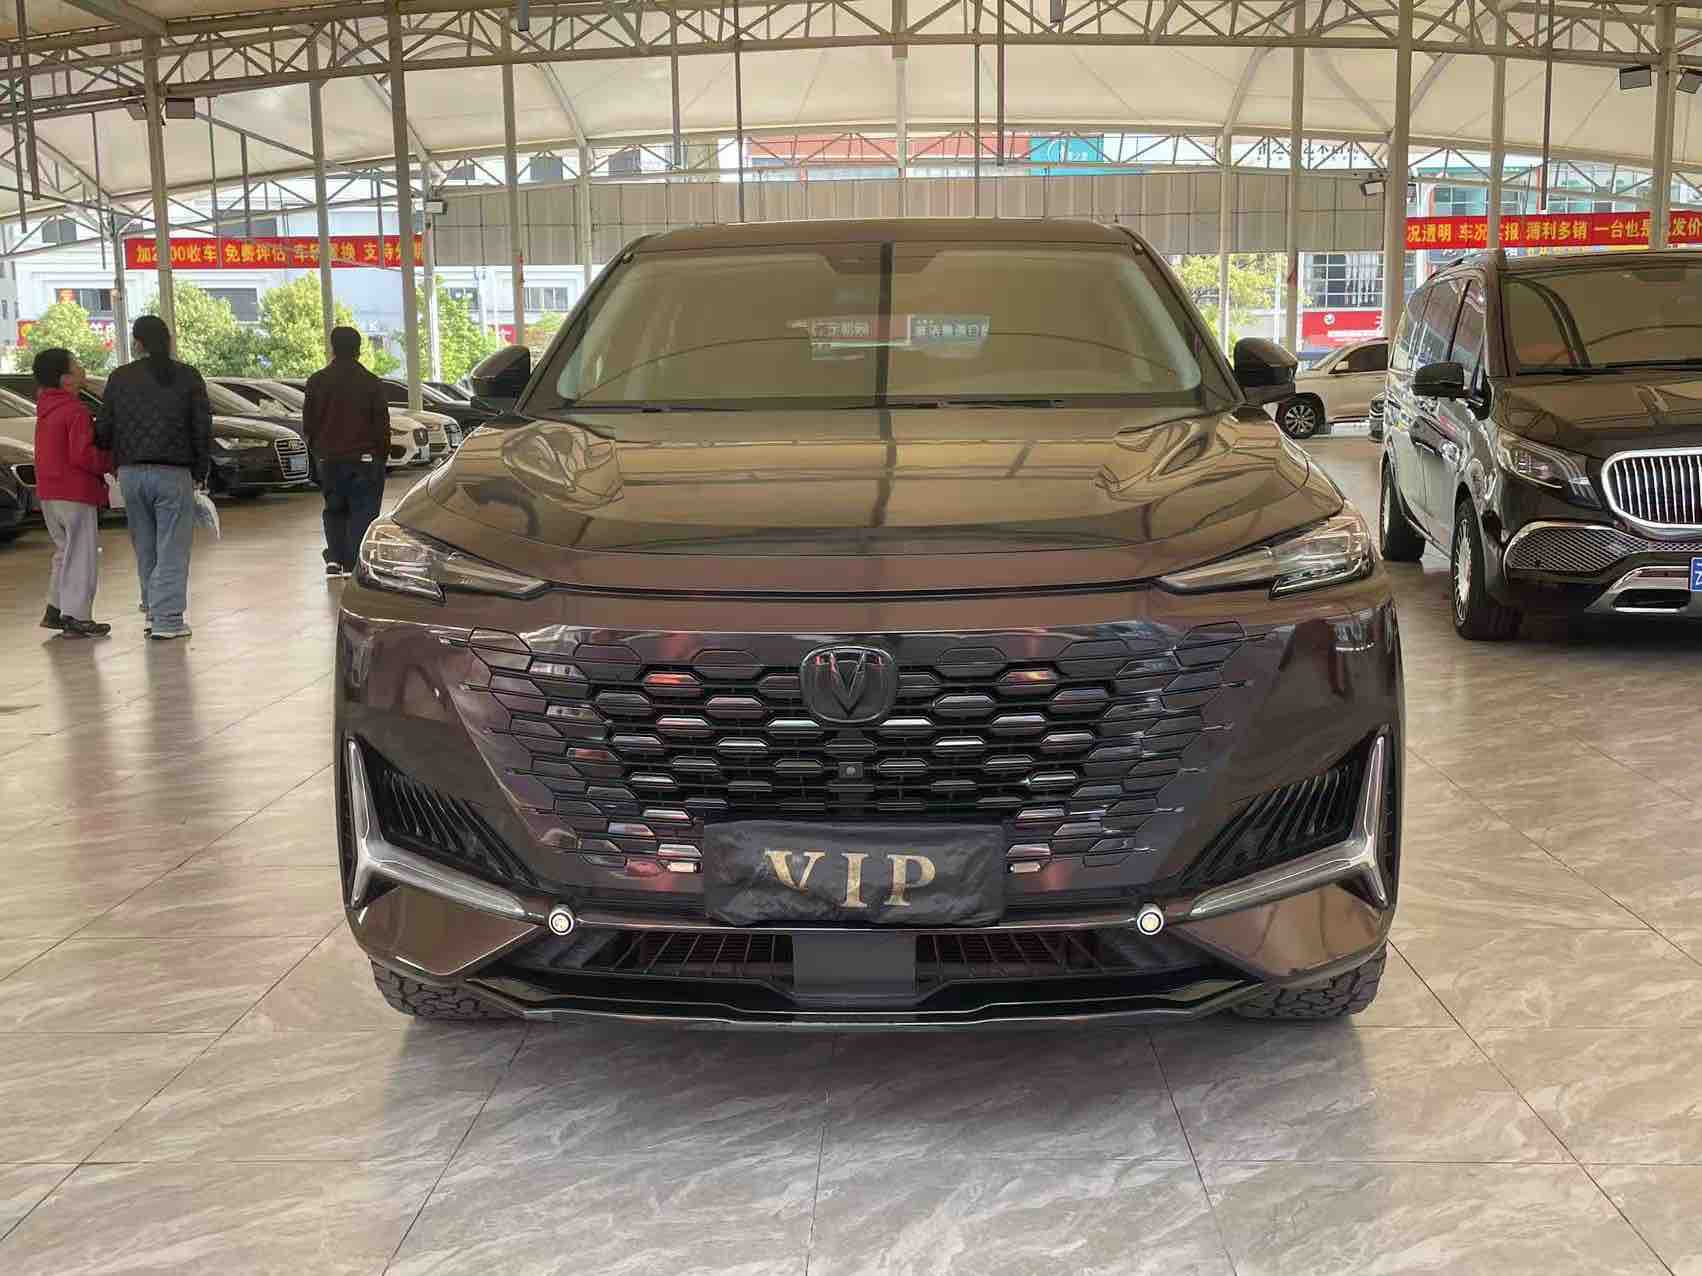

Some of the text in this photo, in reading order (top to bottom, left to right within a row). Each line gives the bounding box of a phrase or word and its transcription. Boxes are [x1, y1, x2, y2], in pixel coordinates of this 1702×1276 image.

[1458, 221, 1519, 242] 车况报
[1594, 216, 1702, 239] 一台也是发价
[764, 850, 936, 908] VIP
